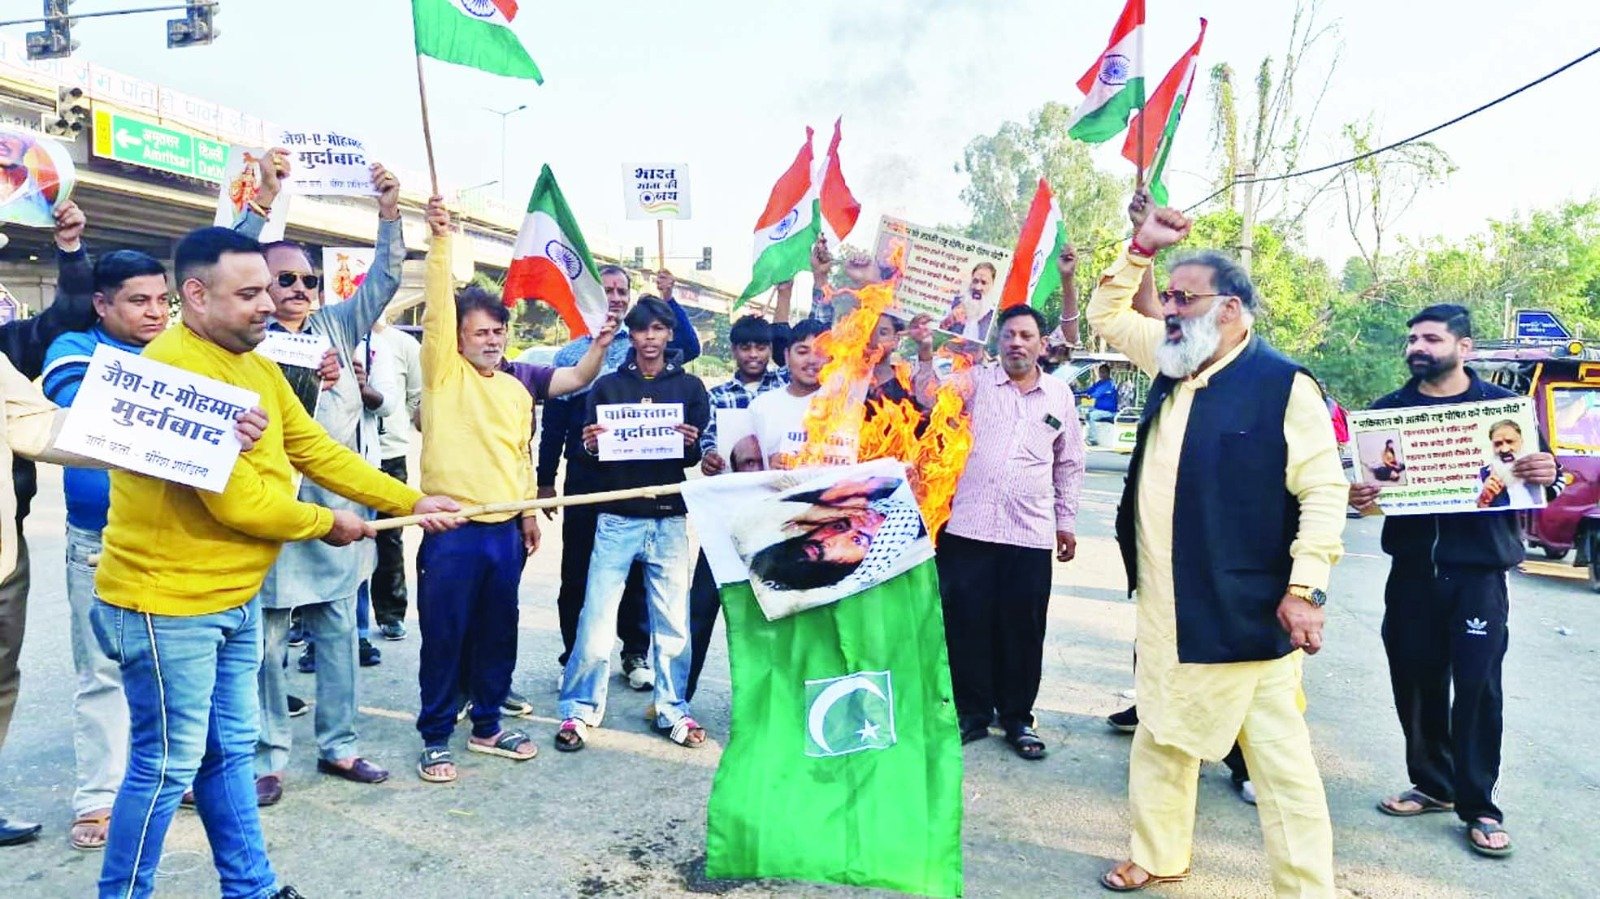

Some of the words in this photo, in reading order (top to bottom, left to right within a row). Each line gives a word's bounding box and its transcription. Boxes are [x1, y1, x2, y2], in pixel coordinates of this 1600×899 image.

[143, 146, 191, 169] Amritsar
[298, 148, 366, 169] मुर्दाबाद
[635, 168, 676, 179] भारत
[665, 179, 677, 189] की
[656, 192, 679, 201] जय
[604, 407, 678, 420] पाकिस्तान
[111, 398, 226, 446] मुर्दाबाद
[613, 424, 675, 442] मुर्दाबाद
